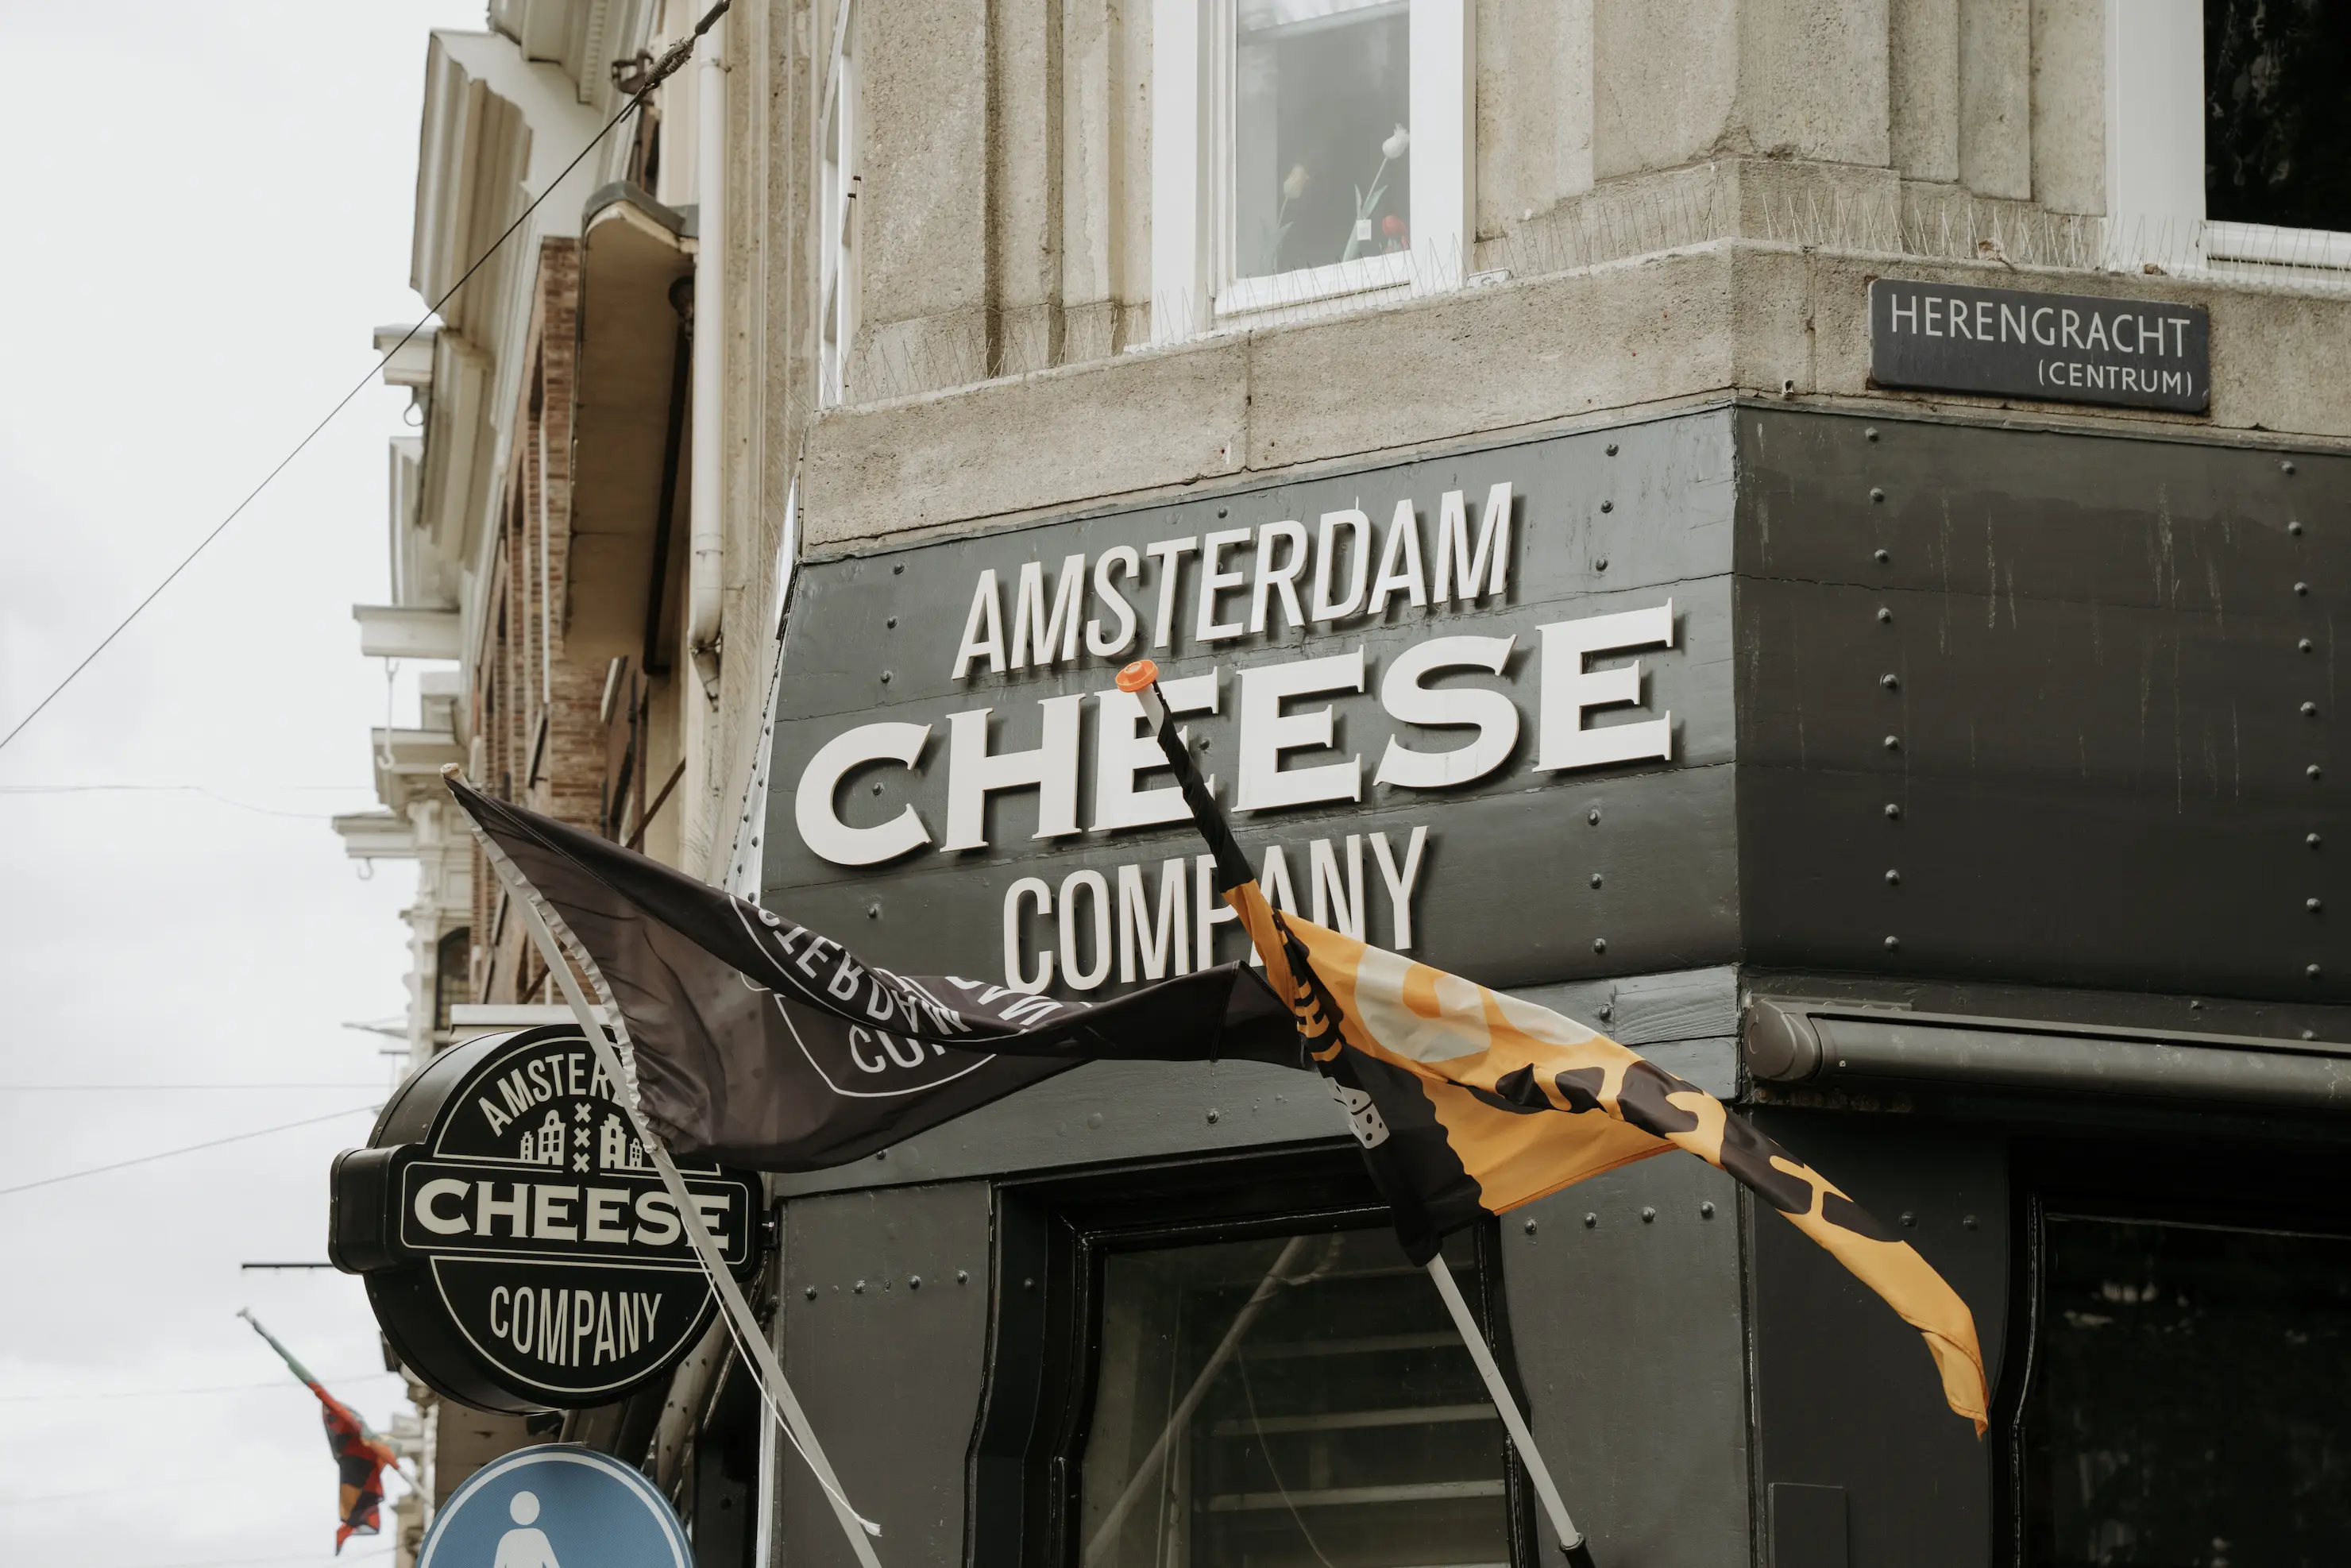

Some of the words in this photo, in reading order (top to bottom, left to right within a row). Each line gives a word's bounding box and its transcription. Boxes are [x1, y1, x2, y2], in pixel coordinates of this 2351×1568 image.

[1891, 293, 2191, 357] HERENGRACHT
[2038, 359, 2193, 397] (CENTRUM)
[952, 481, 1513, 681] AMSTERDAM
[795, 597, 1674, 866] CHEESE
[1002, 825, 1428, 995] COMPANY
[477, 1052, 626, 1137] AMSTER
[414, 1178, 730, 1251] CHEESE
[489, 1285, 662, 1367] COMPANY
